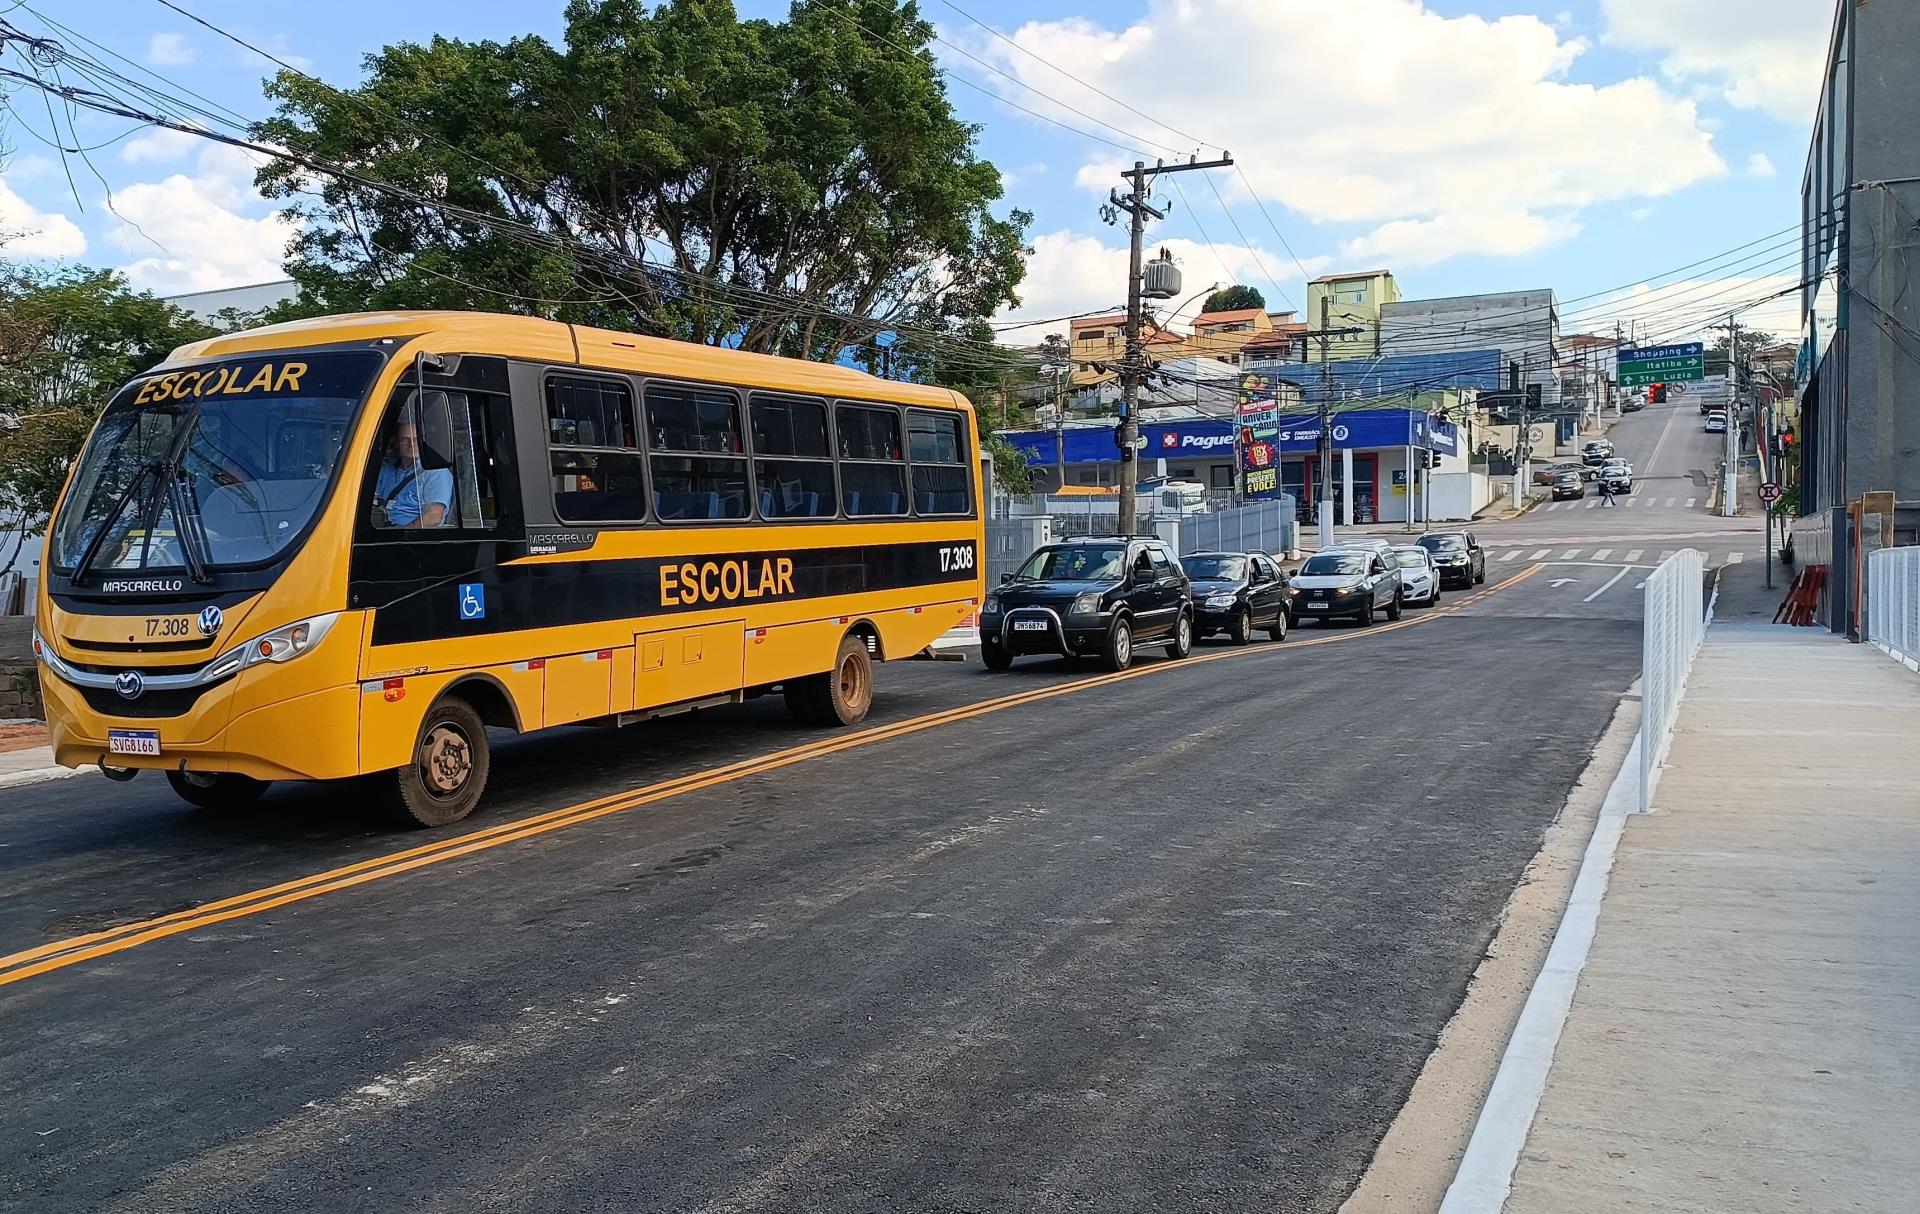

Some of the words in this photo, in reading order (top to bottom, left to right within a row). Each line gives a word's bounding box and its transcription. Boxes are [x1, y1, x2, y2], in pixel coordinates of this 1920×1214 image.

[1633, 348, 1681, 358] Shopping
[1647, 361, 1682, 369] Itatiba
[1663, 371, 1692, 381] Luzia
[133, 362, 308, 405] ESCOLAR
[1182, 435, 1234, 449] Pague
[529, 533, 594, 545] MASCARELLO
[939, 545, 973, 573] 17.308
[102, 580, 182, 592] MASCARELLO
[659, 557, 795, 607] ESCOLAR
[145, 618, 189, 636] 17.308
